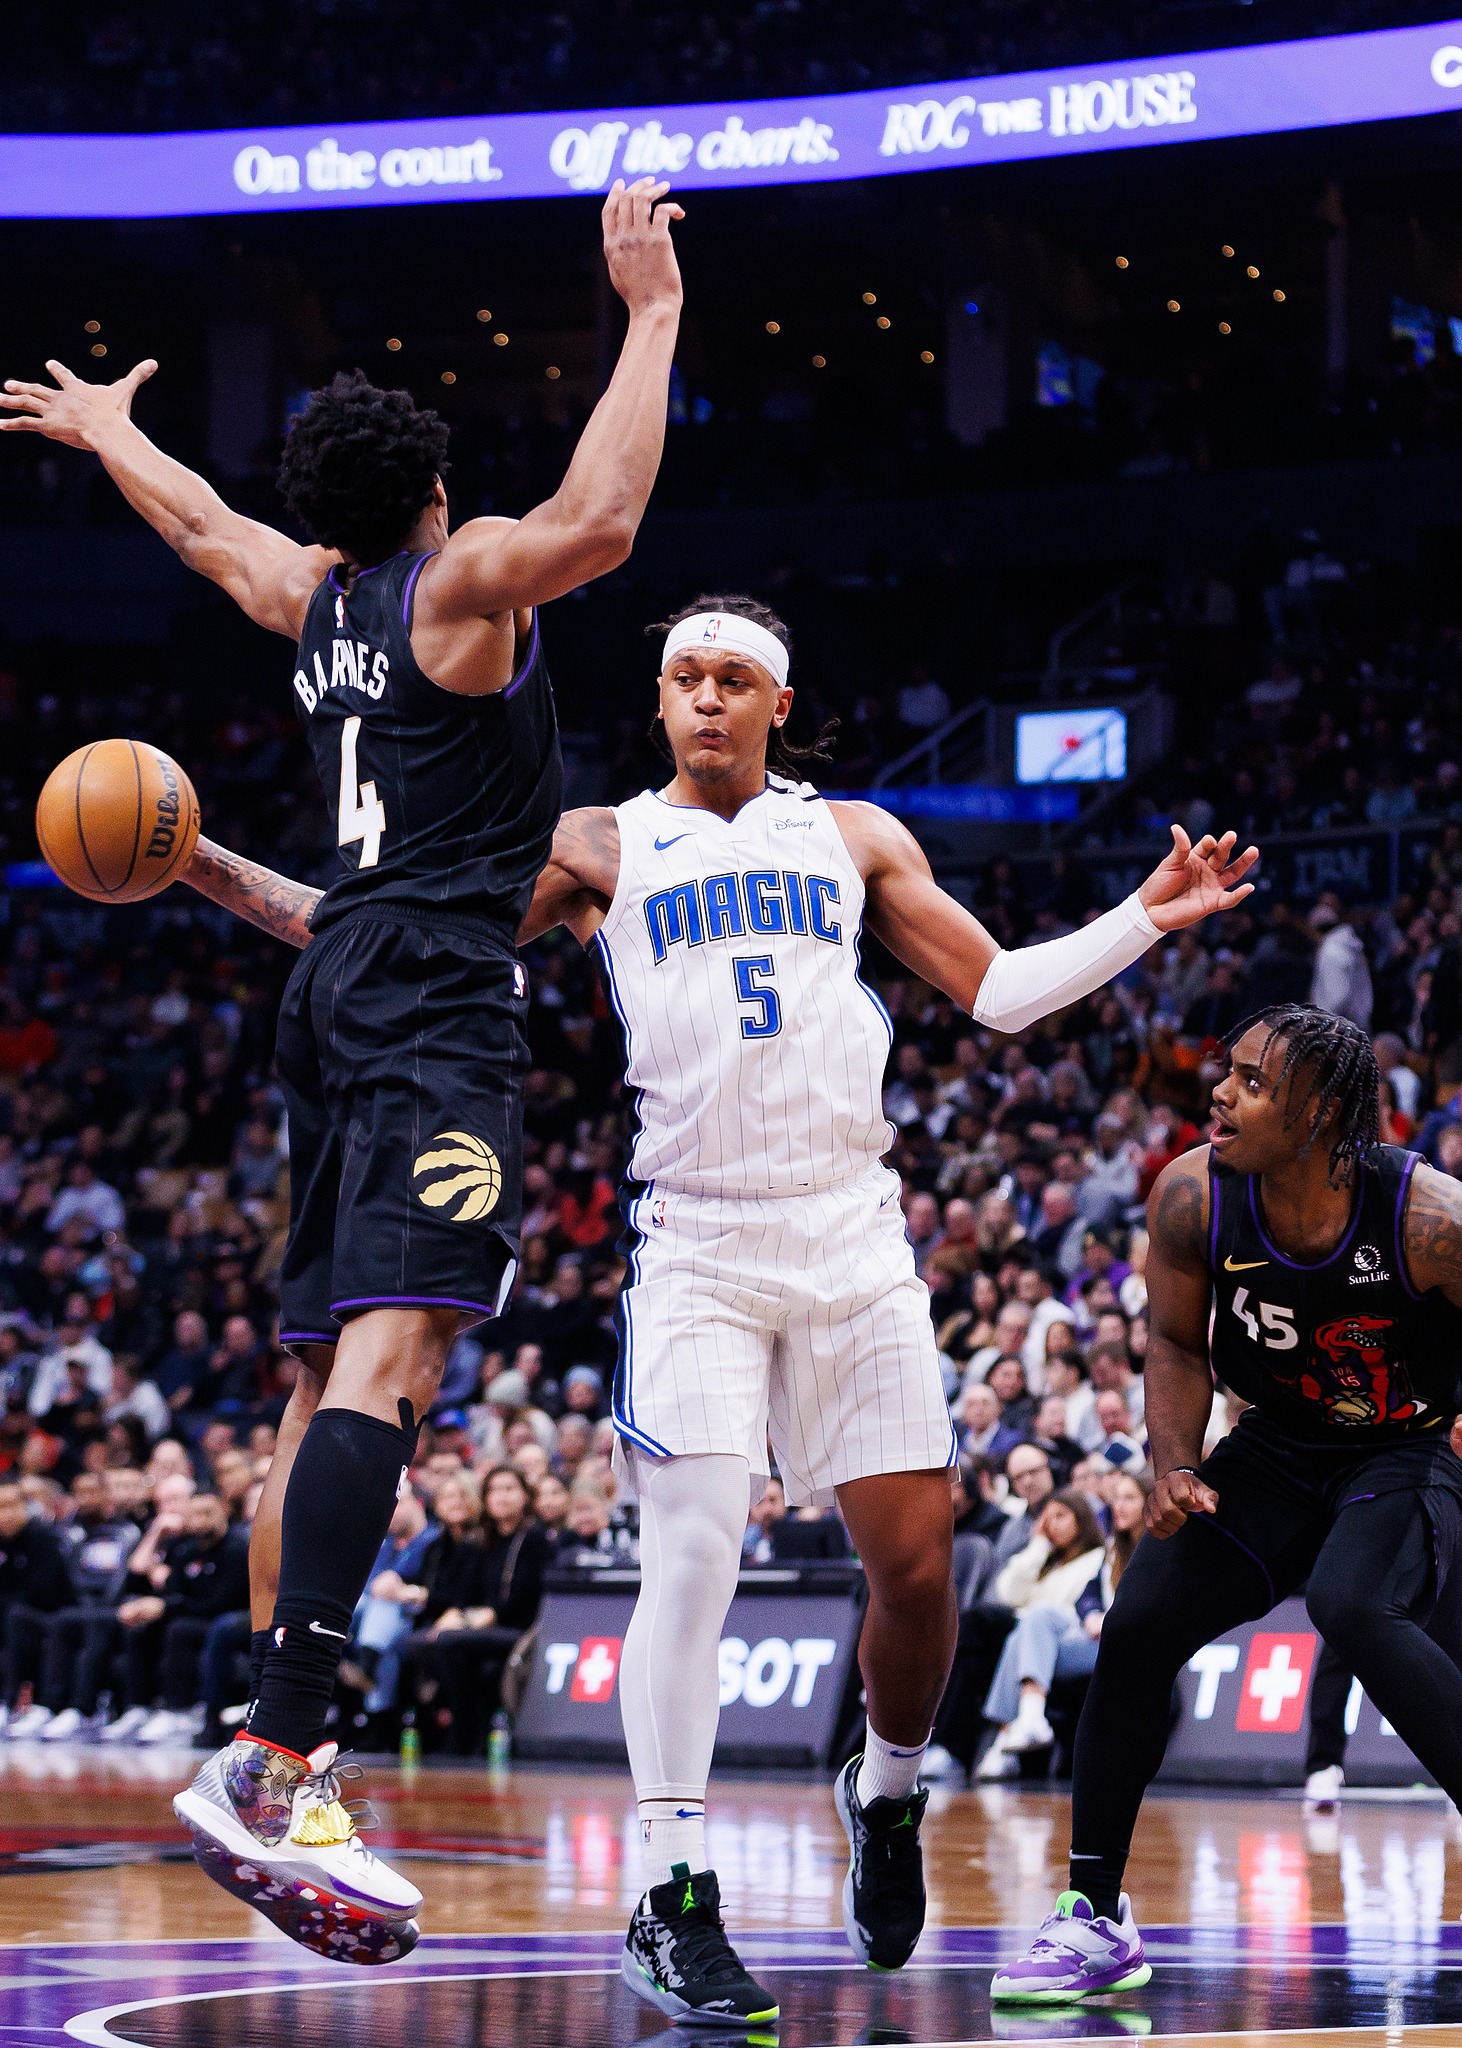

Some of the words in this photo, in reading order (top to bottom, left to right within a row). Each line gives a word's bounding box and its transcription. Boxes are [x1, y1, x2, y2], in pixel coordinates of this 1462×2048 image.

[879, 95, 976, 156] ROC
[977, 97, 1043, 136] THE
[1049, 71, 1198, 137] HOUSE
[233, 145, 301, 195] On
[305, 138, 376, 191] the
[379, 137, 503, 187] court.
[549, 121, 629, 190] Off
[622, 120, 694, 174] the
[696, 116, 840, 170] charts.
[293, 639, 390, 715] BARNES
[145, 759, 180, 858] Wilson
[338, 715, 387, 870] 4
[643, 870, 843, 967] MAGIC
[732, 954, 783, 1040] 5
[1349, 1275, 1369, 1285] Sun
[1370, 1270, 1390, 1282] Life
[1231, 1286, 1299, 1350] 45
[1340, 1375, 1361, 1387] 15
